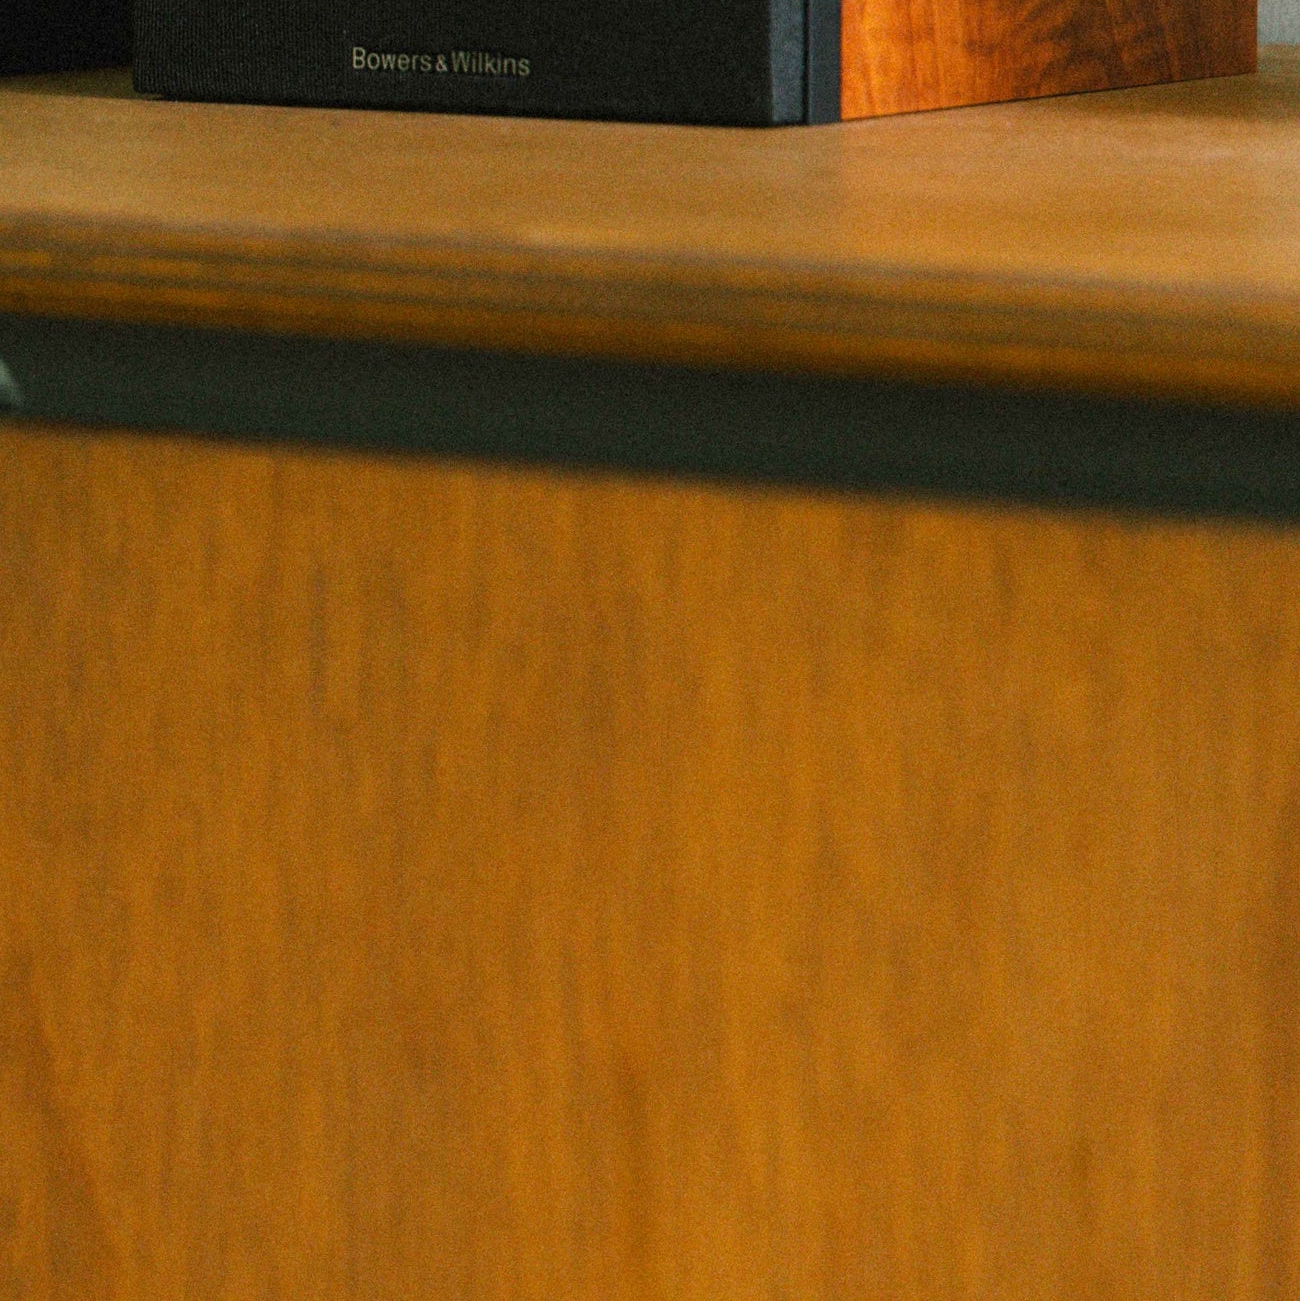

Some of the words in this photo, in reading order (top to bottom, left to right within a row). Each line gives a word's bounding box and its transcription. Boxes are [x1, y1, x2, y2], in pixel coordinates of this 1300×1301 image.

[352, 47, 431, 72] Bowers
[436, 54, 448, 72] &
[451, 50, 531, 77] Wilkins
